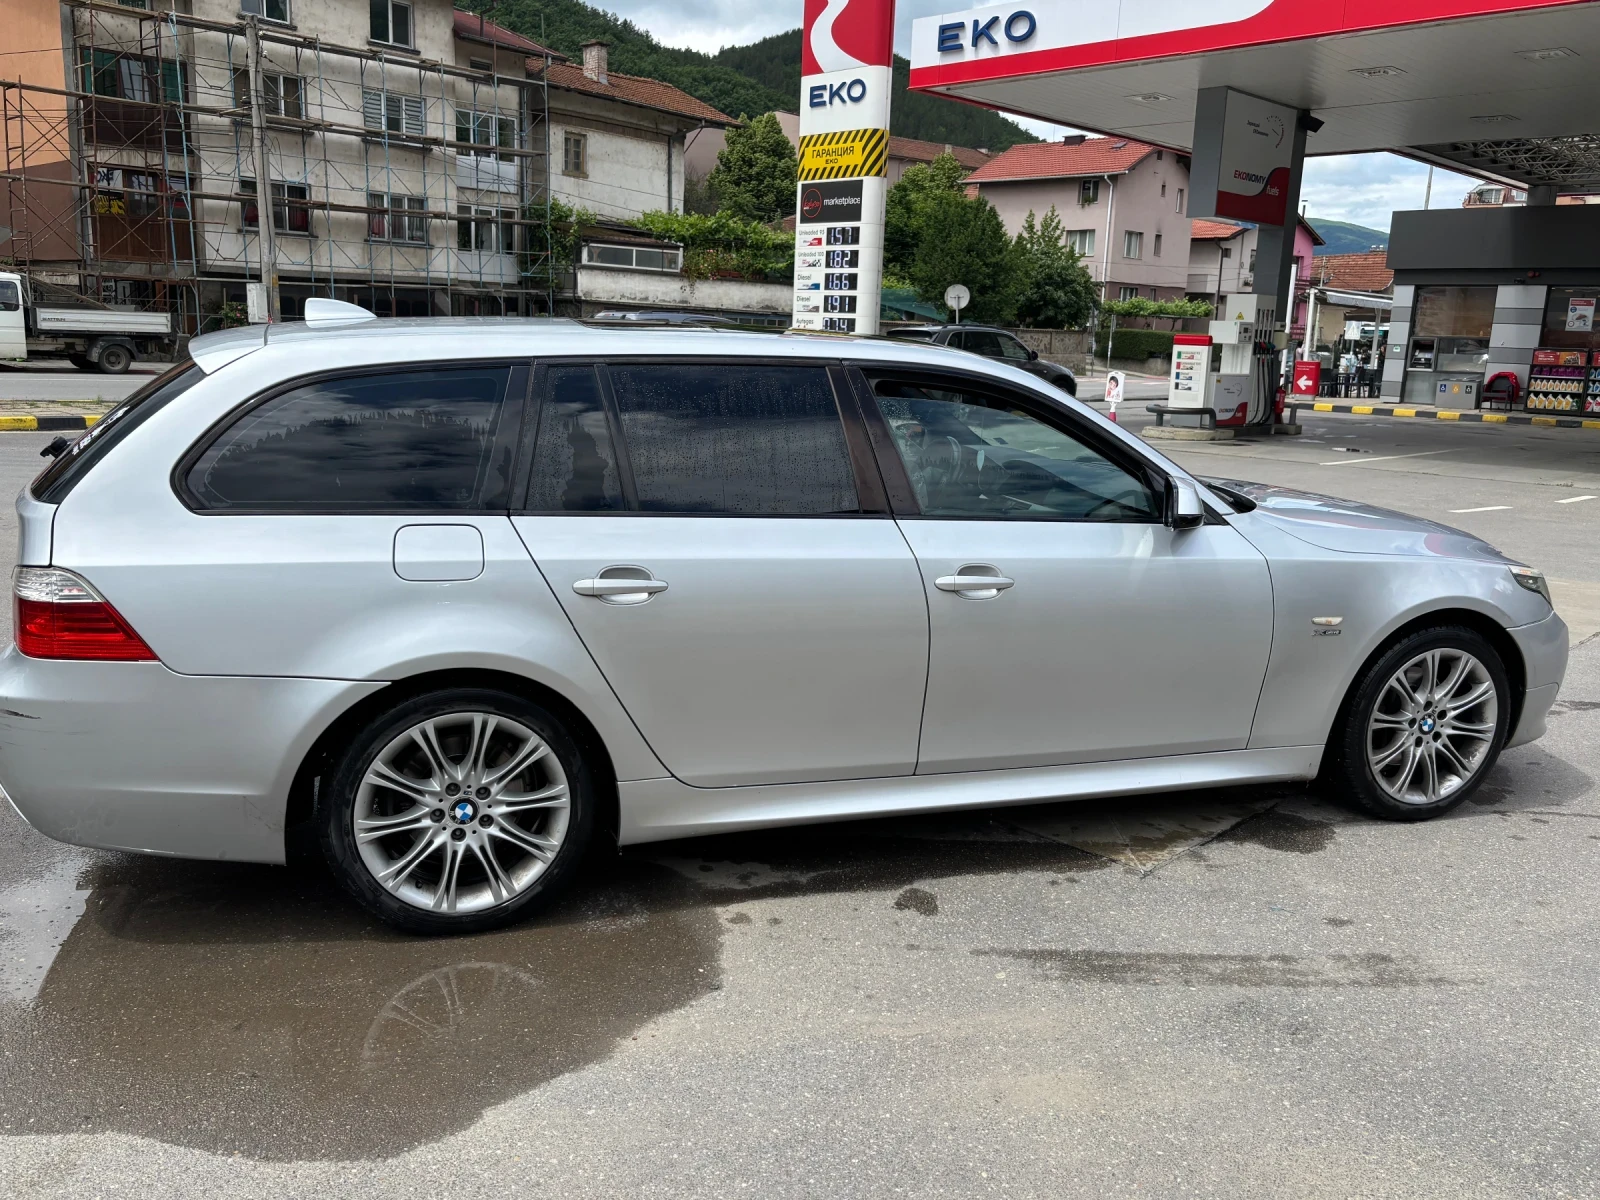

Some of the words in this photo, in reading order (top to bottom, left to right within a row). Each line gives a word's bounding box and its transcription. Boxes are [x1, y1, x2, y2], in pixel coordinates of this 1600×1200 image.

[938, 10, 1037, 53] EKO
[809, 78, 867, 109] EKO
[812, 145, 855, 159] ГАРАНЦИЯ
[1234, 170, 1267, 184] EKONOMY
[1266, 185, 1280, 196] fuels
[823, 196, 861, 207] marketplace
